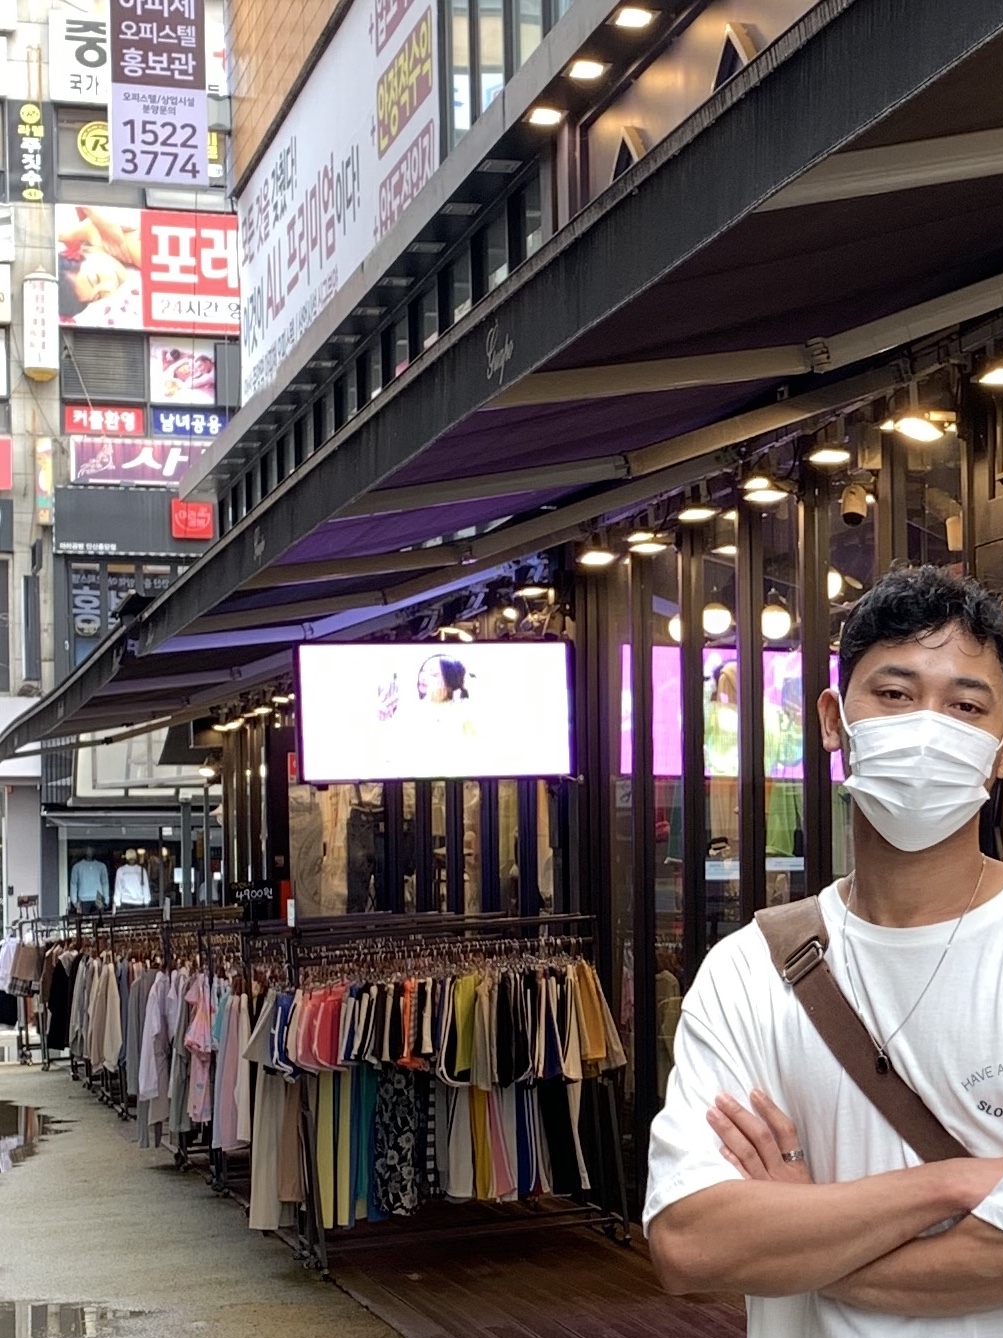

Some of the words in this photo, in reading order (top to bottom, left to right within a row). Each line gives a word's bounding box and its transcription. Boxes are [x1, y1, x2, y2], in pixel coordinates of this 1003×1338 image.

[65, 19, 107, 68] 중
[119, 21, 197, 48] 오피스텔
[120, 47, 197, 81] 홍보관
[123, 92, 195, 108] 오피스텔/상업시설
[122, 118, 199, 150] 1522
[20, 137, 42, 187] 주짓수
[121, 148, 200, 179] 3774
[161, 299, 219, 317] 24시간
[73, 409, 135, 432] 커플환영
[160, 413, 222, 434] 남녀공용
[122, 447, 206, 477] 사
[235, 887, 273, 901] 4900원
[961, 1065, 994, 1091] HAVE
